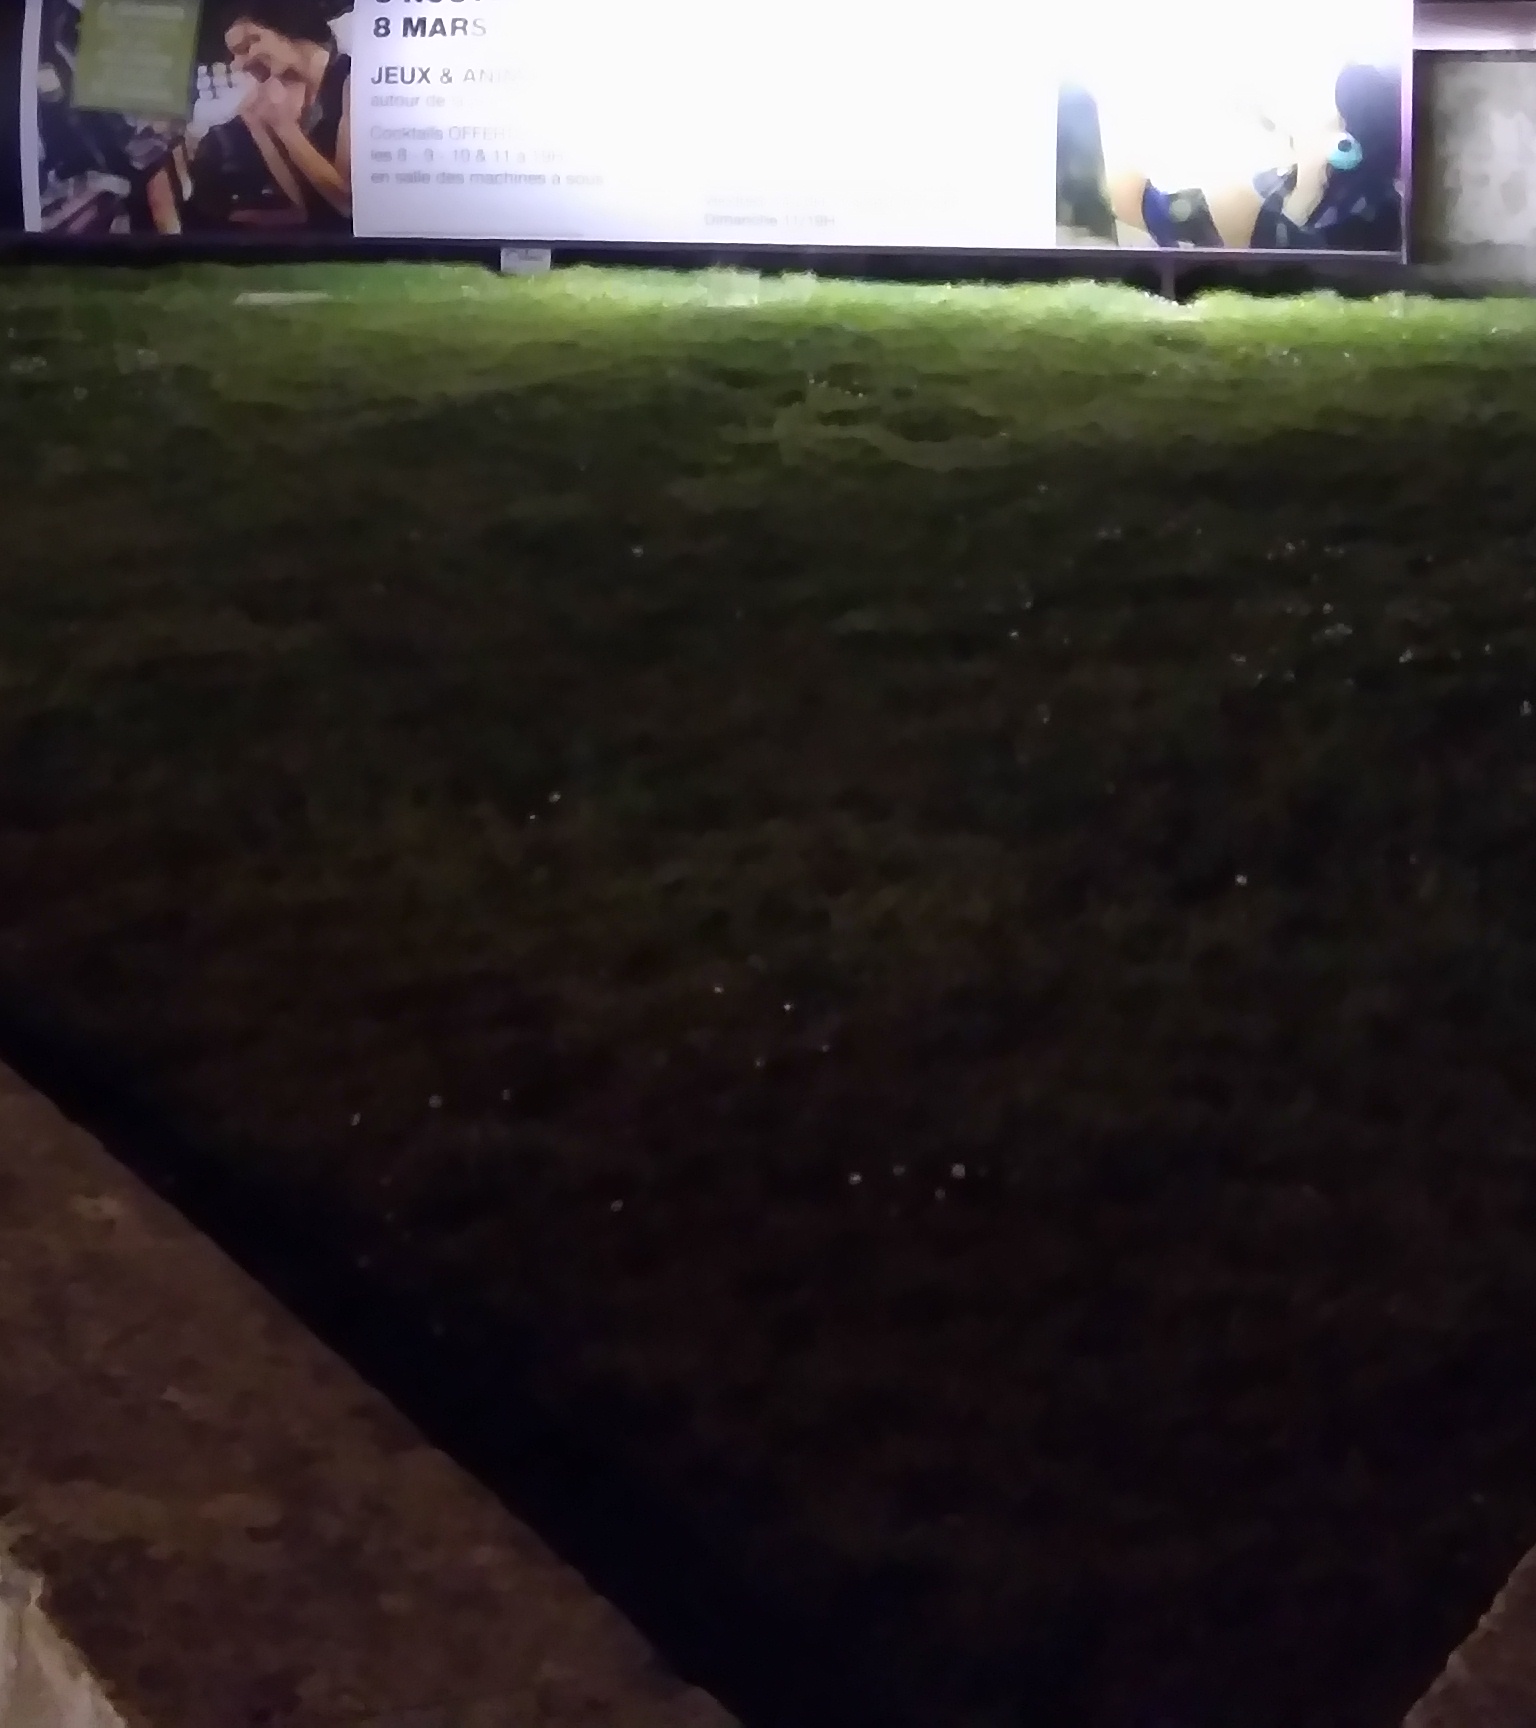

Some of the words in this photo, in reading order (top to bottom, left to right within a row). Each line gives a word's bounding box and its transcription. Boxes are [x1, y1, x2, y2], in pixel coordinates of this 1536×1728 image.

[373, 17, 391, 38] 8
[402, 16, 487, 38] MARS
[371, 66, 431, 85] JEUX
[440, 68, 453, 84] &
[370, 94, 420, 107] autour
[426, 94, 446, 107] de
[470, 171, 546, 184] machines
[566, 174, 604, 185] sous
